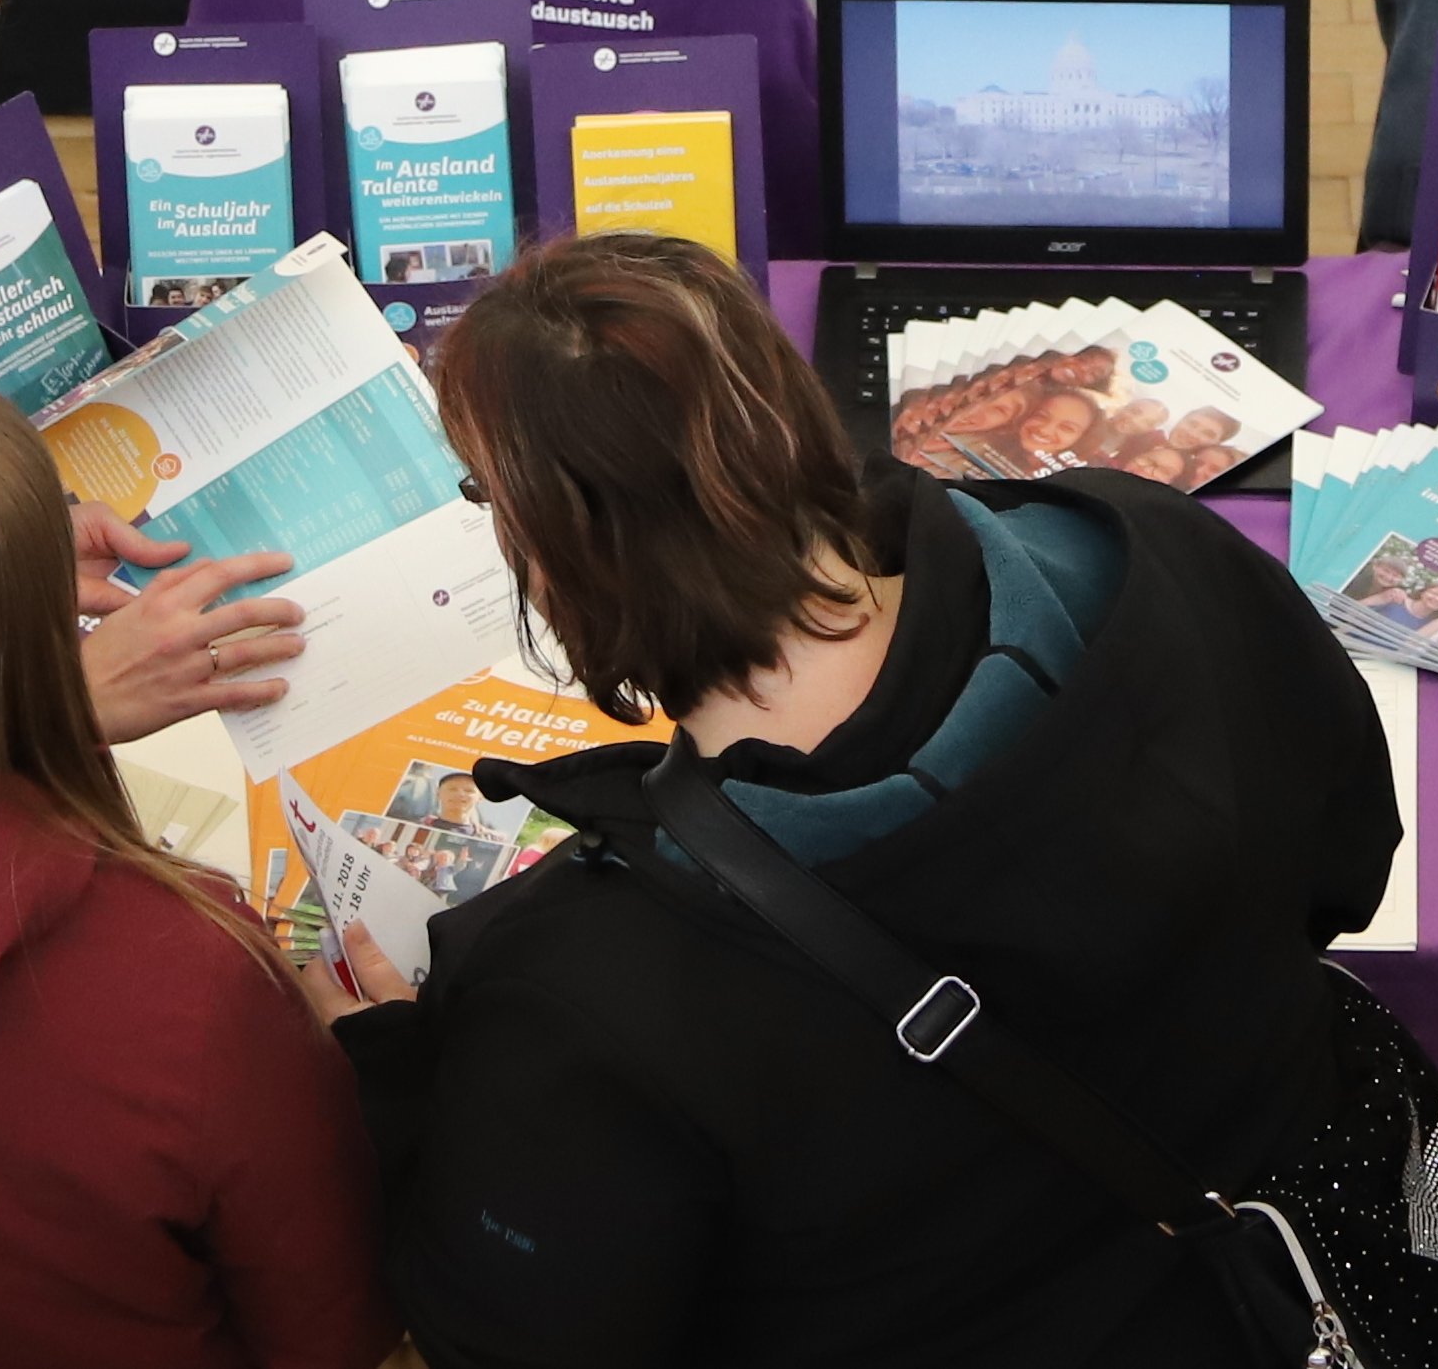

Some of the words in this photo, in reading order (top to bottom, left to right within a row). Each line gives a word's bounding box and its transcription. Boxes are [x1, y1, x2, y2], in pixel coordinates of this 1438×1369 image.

[375, 160, 393, 172] Im
[396, 154, 496, 178] Ausland
[361, 179, 438, 196] Talente
[381, 190, 503, 208] weiterentwickeln
[150, 200, 171, 212] Ein
[175, 200, 271, 223] Schuljahr
[158, 218, 175, 230] im
[174, 219, 257, 237] Ausland
[1048, 241, 1087, 252] acer
[15, 294, 75, 339] schlau!
[424, 305, 467, 316] Austau
[463, 699, 487, 714] Zu
[488, 700, 589, 734] Hause
[435, 710, 465, 725] die
[465, 717, 553, 752] Welt
[337, 853, 356, 888] 2018
[348, 892, 362, 912] 18
[360, 864, 373, 893] Uhr
